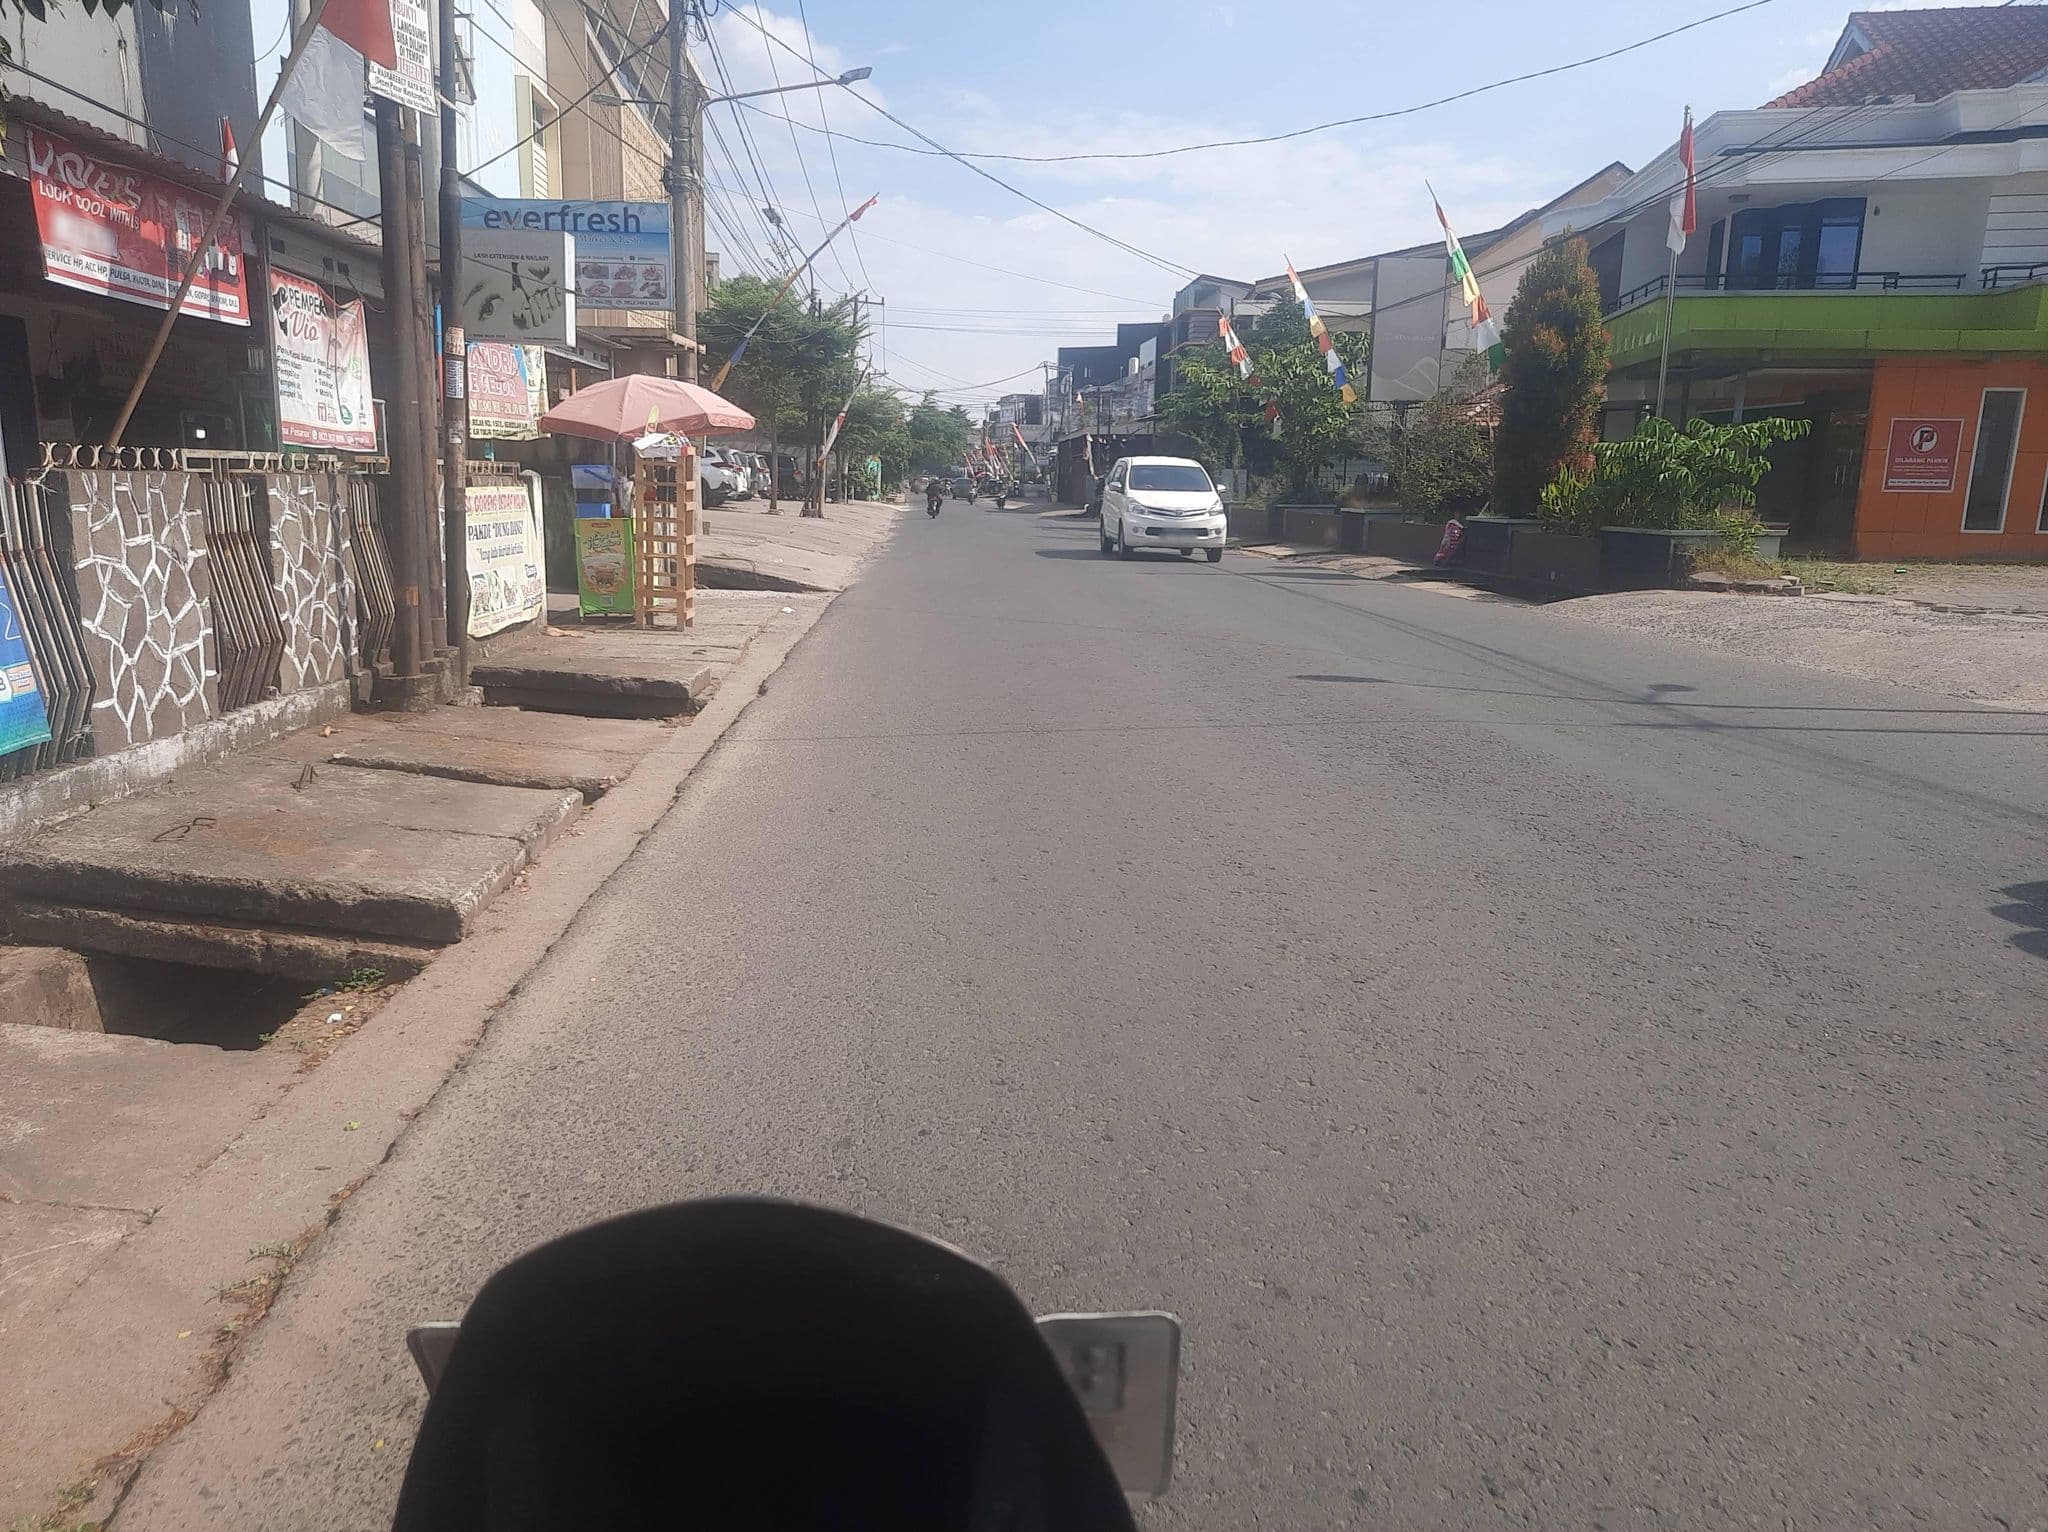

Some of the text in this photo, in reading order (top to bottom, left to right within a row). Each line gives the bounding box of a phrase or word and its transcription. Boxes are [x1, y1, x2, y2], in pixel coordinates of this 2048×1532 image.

[396, 30, 409, 46] BISA
[39, 180, 73, 205] LOOK
[74, 194, 106, 218] COOL
[484, 205, 641, 233] everfresh
[289, 310, 320, 341] Vio
